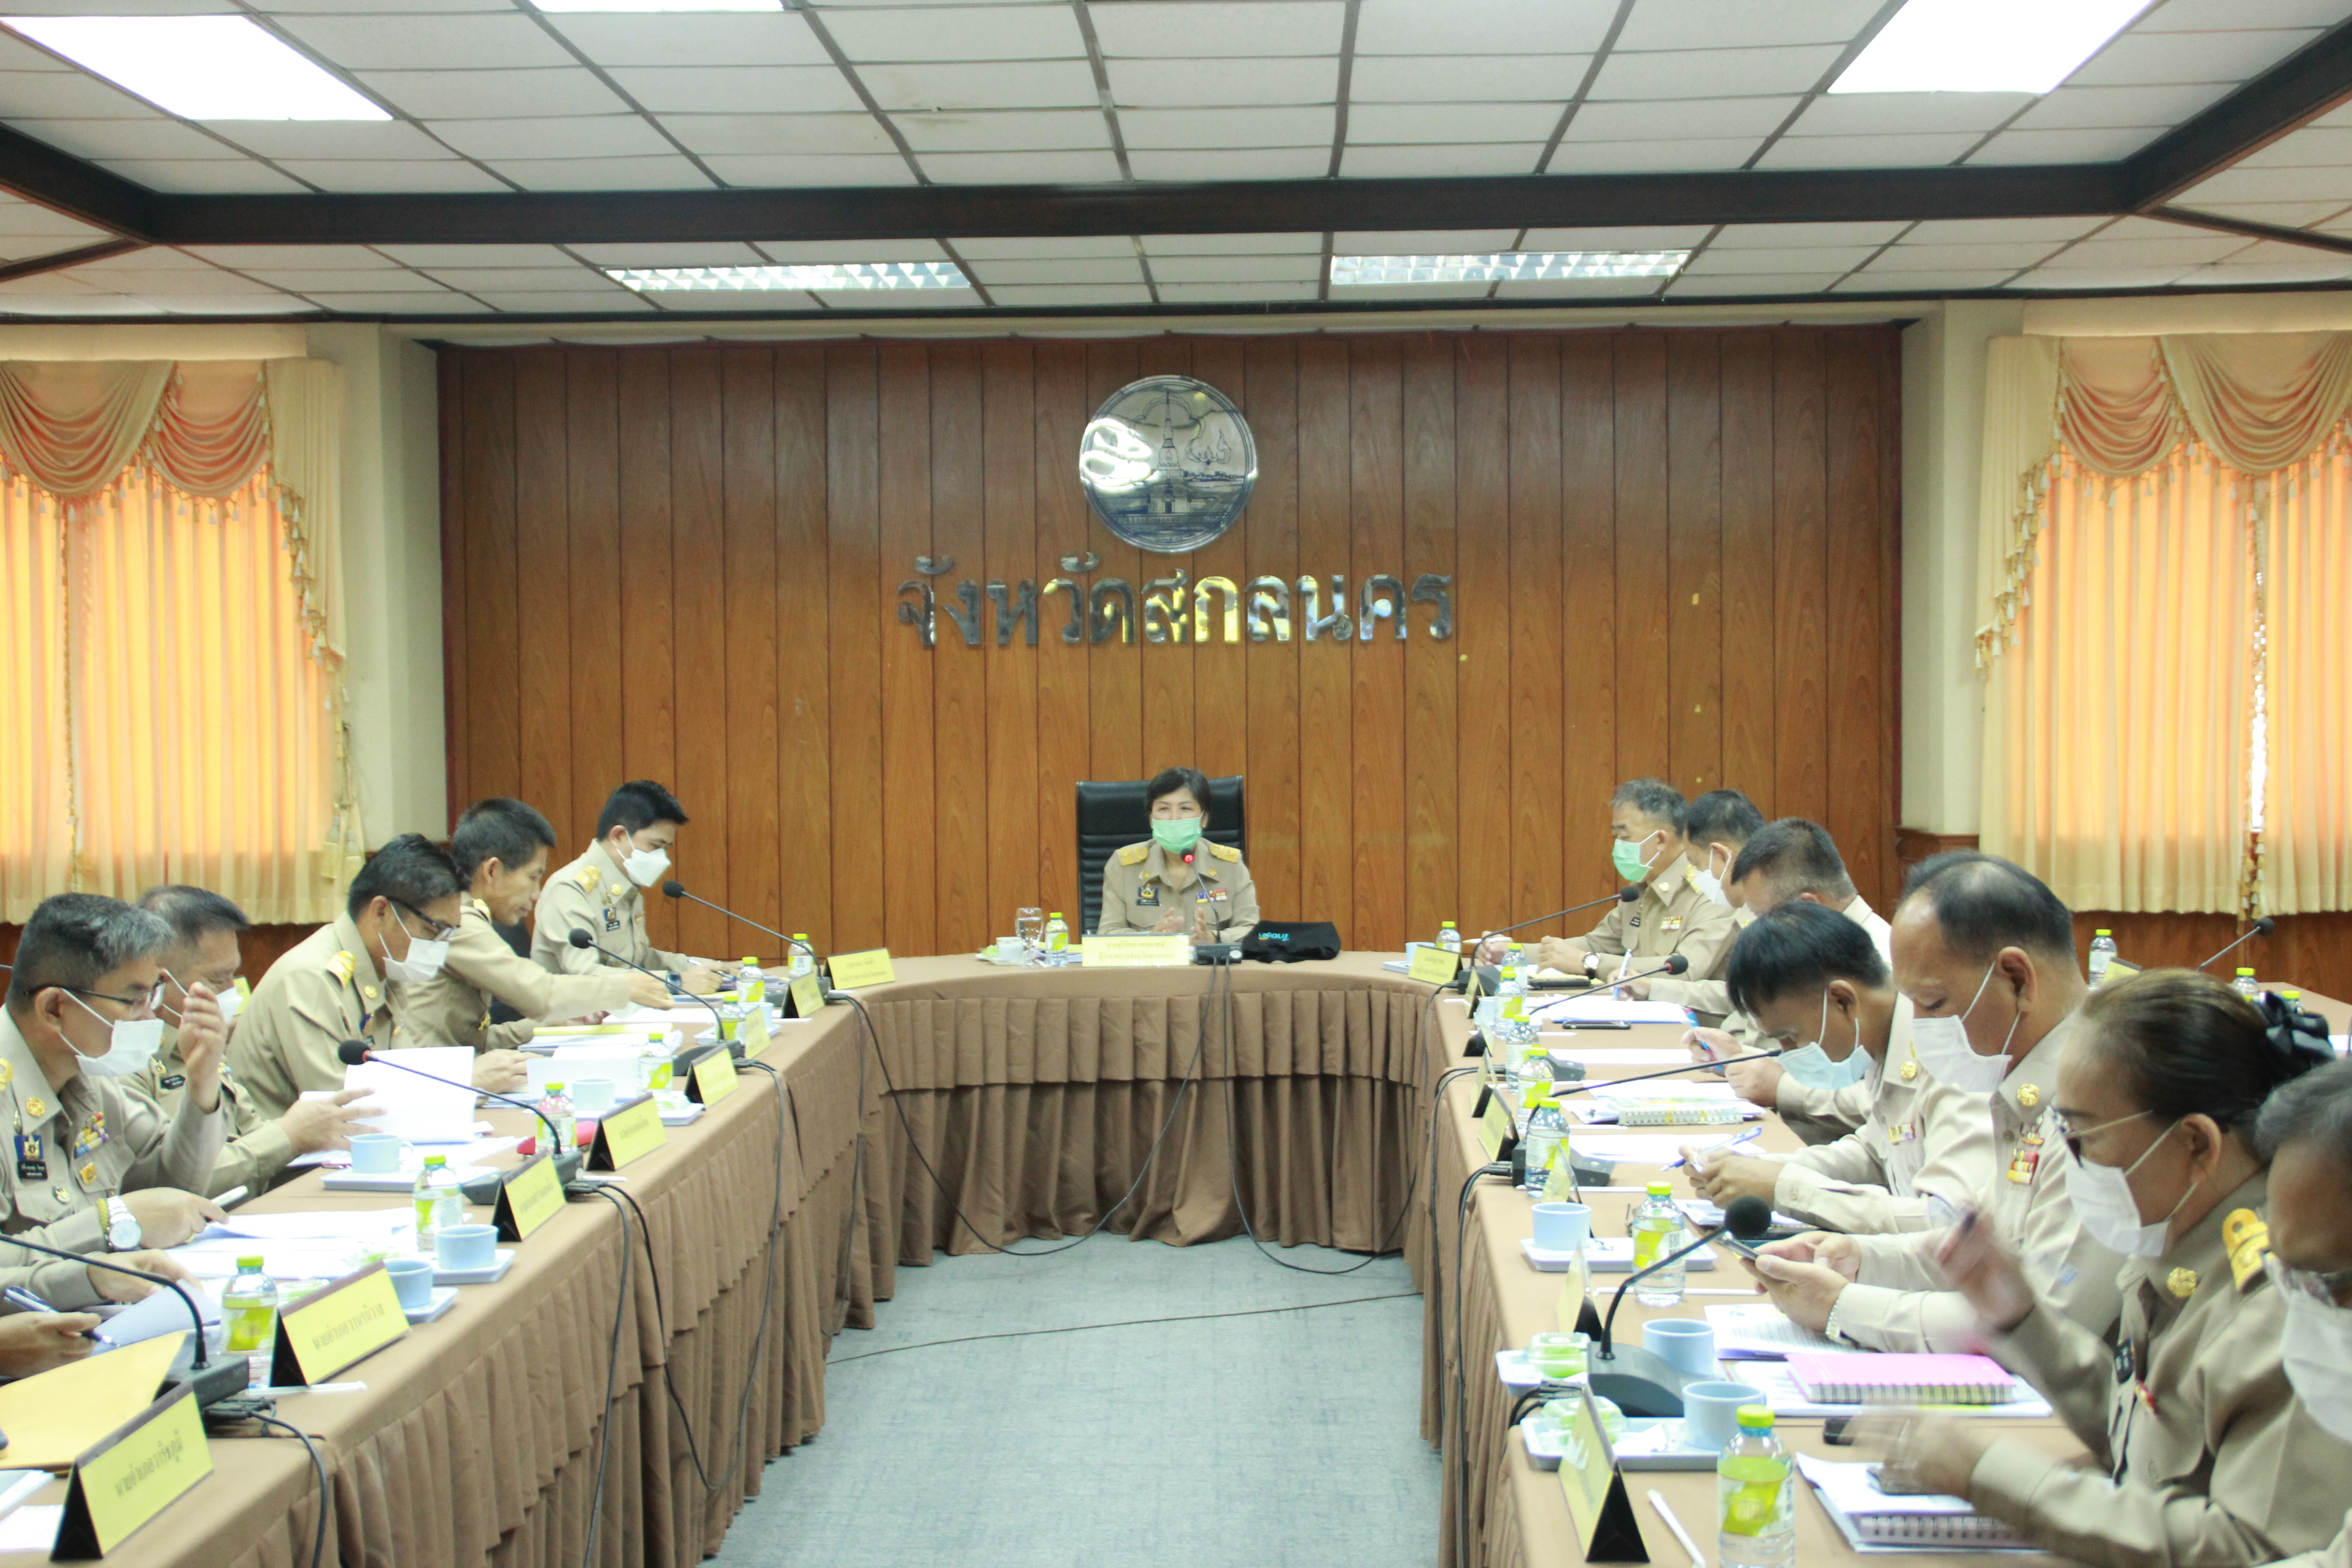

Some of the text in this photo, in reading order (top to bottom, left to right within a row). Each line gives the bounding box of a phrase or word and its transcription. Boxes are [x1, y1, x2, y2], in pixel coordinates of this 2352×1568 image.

[897, 552, 1452, 645] จังหวัดสกลนคร
